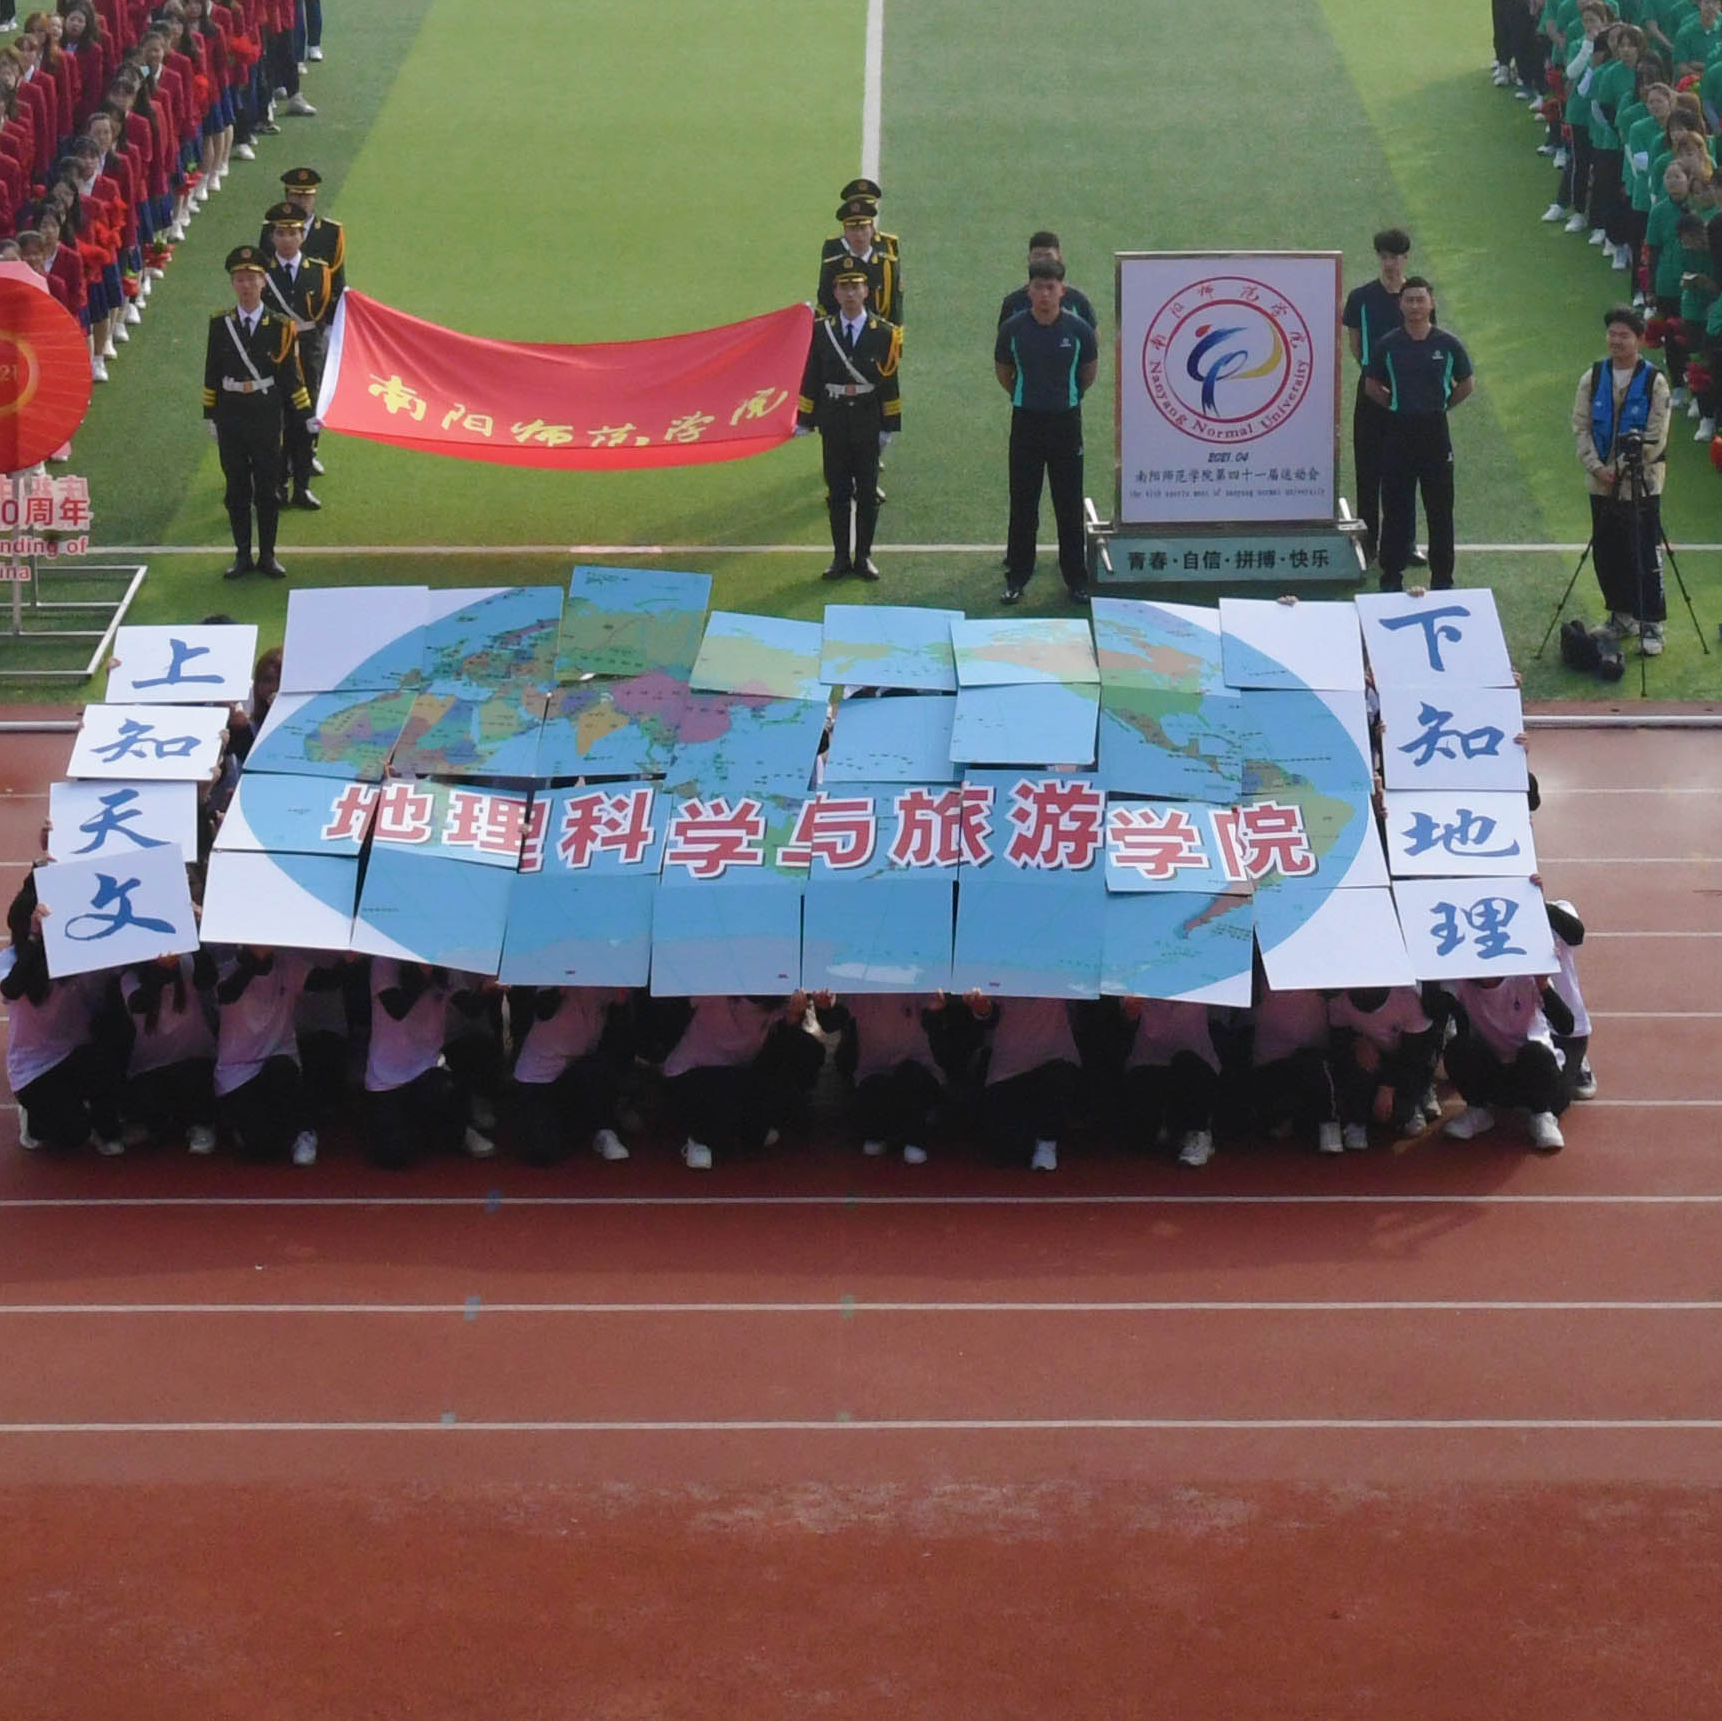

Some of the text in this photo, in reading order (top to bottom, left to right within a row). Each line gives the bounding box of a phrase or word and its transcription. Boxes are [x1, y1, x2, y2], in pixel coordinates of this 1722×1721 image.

[367, 374, 788, 448] 南阳师范学院
[1192, 419, 1254, 440] Normal
[66, 536, 88, 554] of
[64, 638, 225, 942] 上知天文
[1378, 604, 1528, 960] 下知地理
[321, 778, 1317, 879] 地理科学与旅游学院
